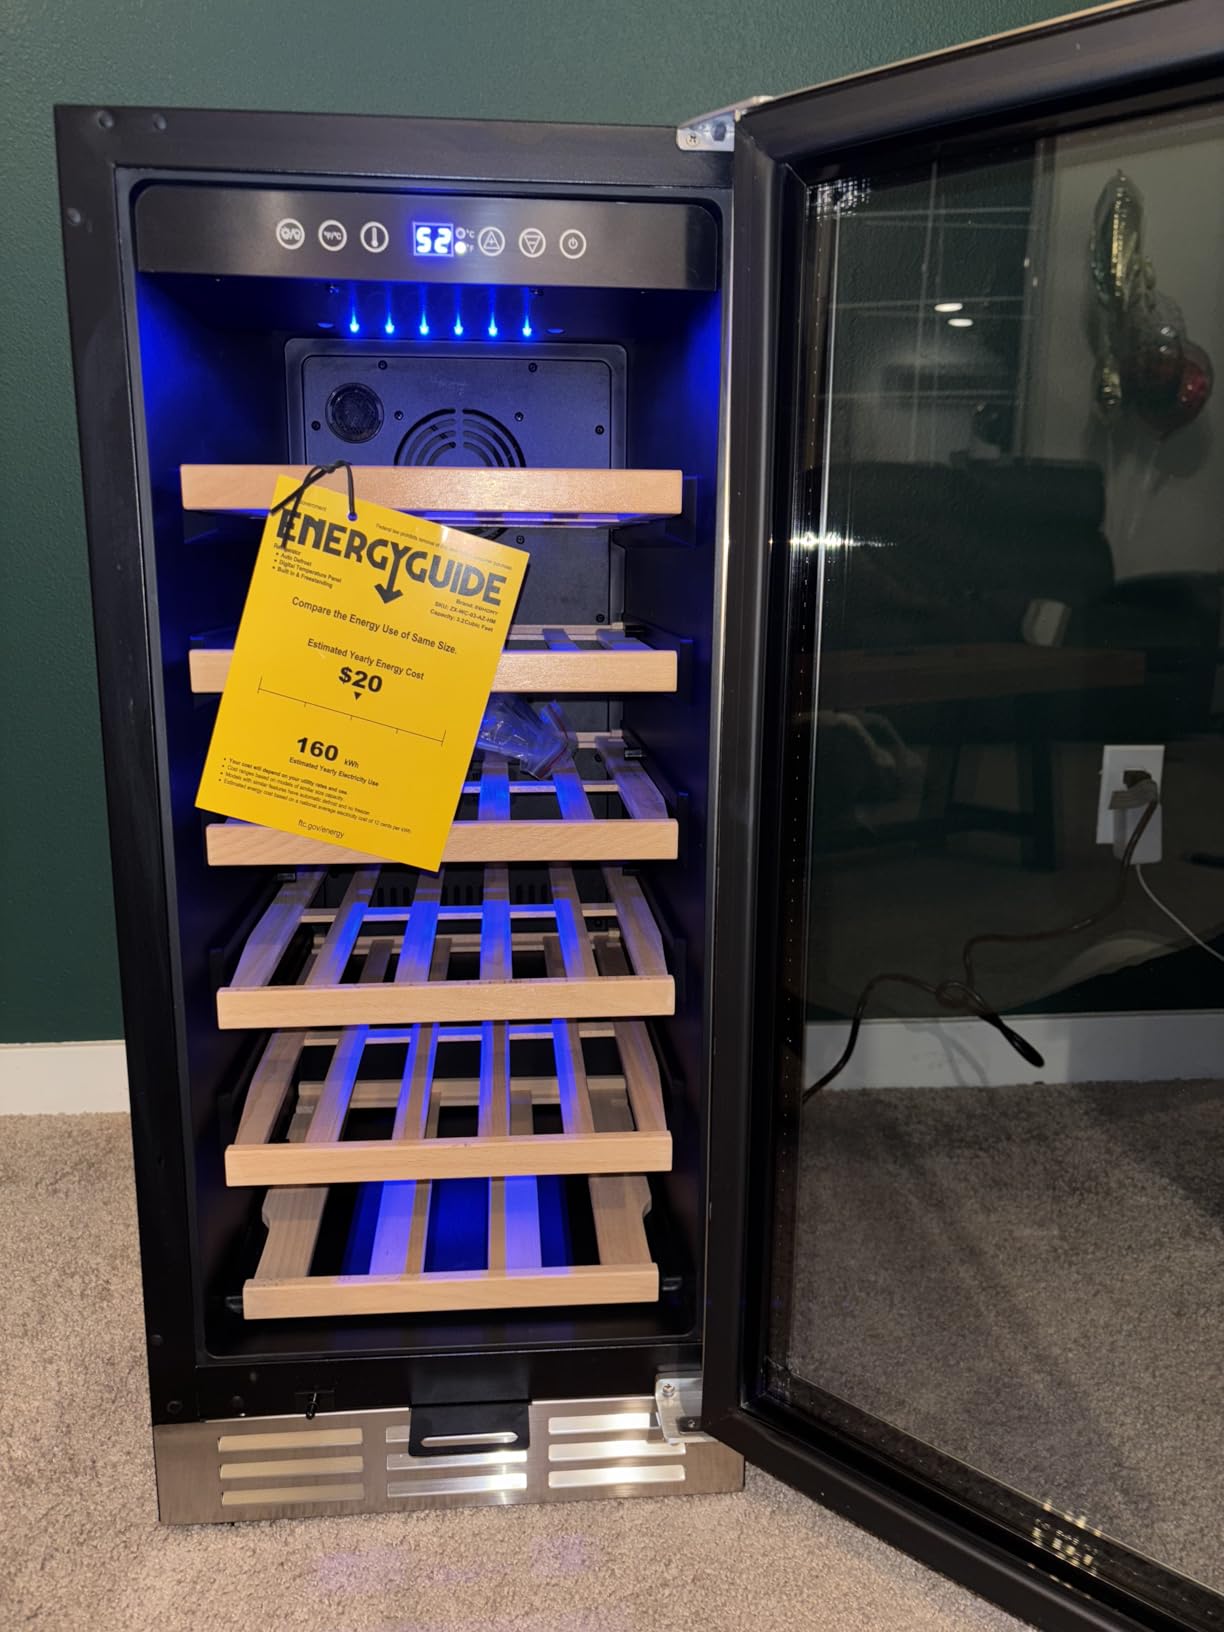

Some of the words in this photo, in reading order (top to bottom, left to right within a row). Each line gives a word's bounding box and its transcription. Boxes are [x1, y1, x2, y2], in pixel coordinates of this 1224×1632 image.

[416, 226, 452, 254] 52
[276, 509, 507, 607] ENERGYGUIDE
[292, 596, 332, 616] Compare
[333, 609, 348, 621] the
[349, 613, 381, 633] Energy
[382, 623, 399, 637] Use
[400, 631, 411, 640] of
[411, 632, 436, 648] Same
[437, 640, 457, 654] Size.
[307, 638, 348, 657] Estimated
[350, 650, 375, 667] Yearly
[375, 658, 404, 676] Energy
[405, 667, 425, 681] Cost
[339, 666, 383, 693] $20
[297, 737, 339, 761] 160
[344, 759, 359, 769] kWh
[289, 756, 319, 770] Estimated
[319, 765, 338, 777] Yearly
[338, 770, 367, 785] Electricity
[367, 778, 379, 787] Use
[298, 819, 345, 839] ftc.gov/energy
